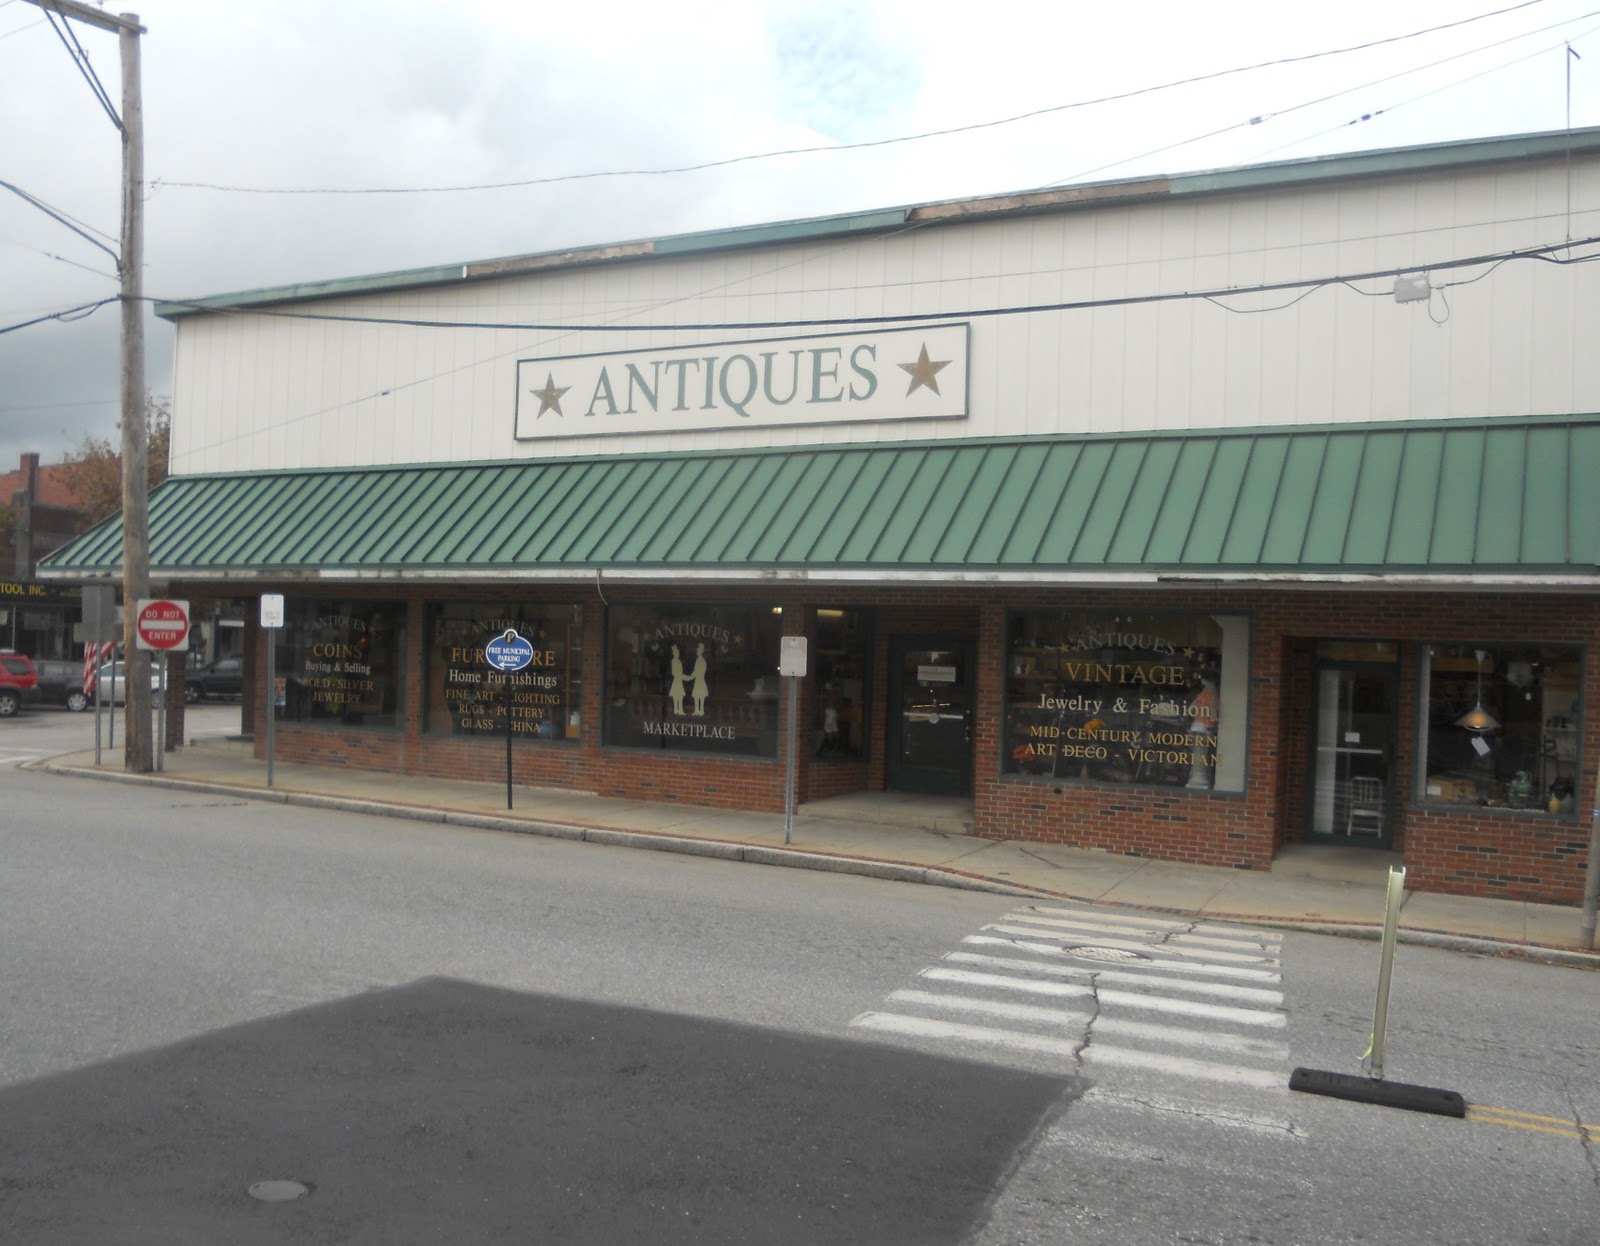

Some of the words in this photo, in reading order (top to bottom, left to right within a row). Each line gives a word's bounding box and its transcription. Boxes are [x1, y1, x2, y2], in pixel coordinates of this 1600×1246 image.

[584, 344, 879, 417] ANTIQUES
[0, 583, 26, 595] TOOL
[145, 610, 158, 619] DO
[163, 610, 180, 619] NOT
[149, 631, 177, 641] ENTER
[507, 633, 515, 643] P
[654, 623, 730, 643] ANTIQUES
[313, 643, 363, 659] COINS
[503, 648, 530, 656] MUNICIPAL
[1075, 632, 1177, 656] ANTIQUES
[452, 647, 556, 666] FURRE
[305, 660, 331, 673] Buying
[334, 662, 341, 672] &
[344, 663, 371, 676] Selling
[449, 669, 481, 683] Home
[1066, 662, 1185, 686] VINTAGE
[337, 679, 374, 691] SILVER
[312, 691, 361, 703] JEWELRY
[446, 688, 469, 700] FINE
[475, 690, 495, 701] ART
[510, 692, 560, 705] IGHTING
[459, 704, 485, 715] RUGS
[1038, 693, 1102, 714] Jewelry
[1112, 697, 1128, 714] &
[1139, 698, 1210, 718] Fashion
[511, 721, 541, 733] HINA
[643, 721, 736, 739] MARKETPLACE
[1030, 726, 1141, 743] MID-CENTURY
[1149, 732, 1218, 748] MODERN
[1025, 743, 1056, 755] ART
[1064, 745, 1107, 759] DECO
[1128, 749, 1224, 767] VICTORIAN
